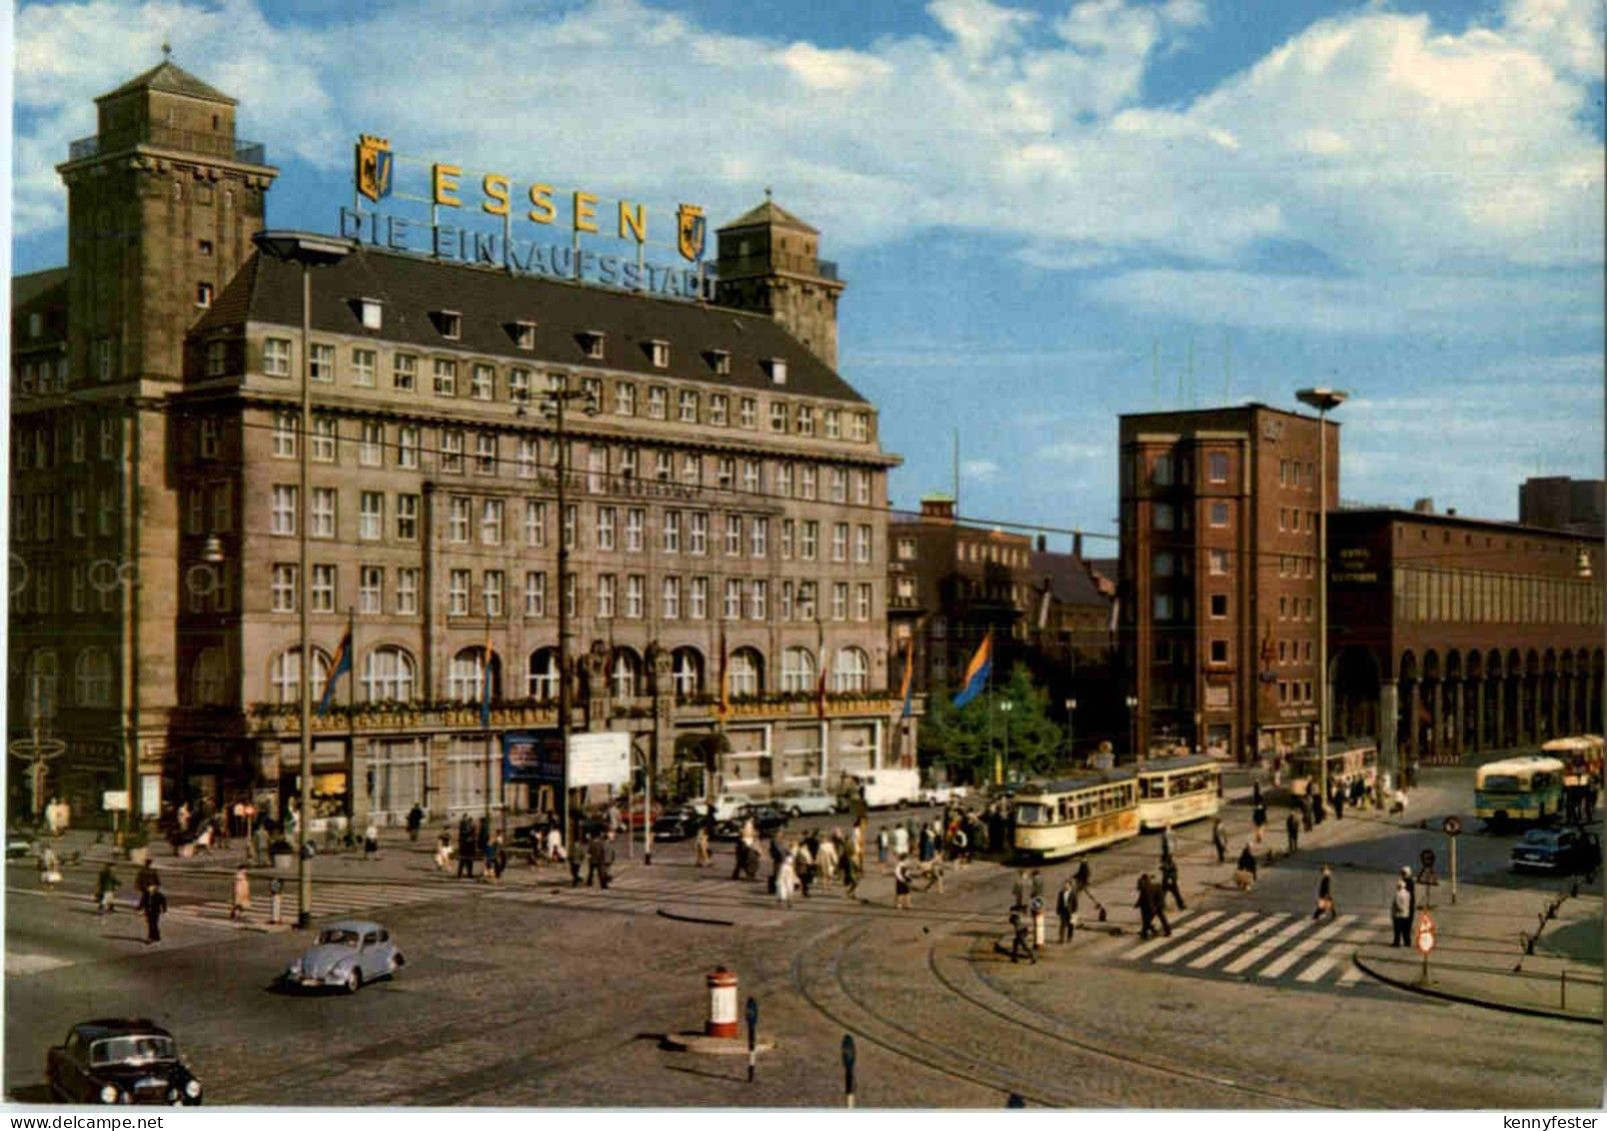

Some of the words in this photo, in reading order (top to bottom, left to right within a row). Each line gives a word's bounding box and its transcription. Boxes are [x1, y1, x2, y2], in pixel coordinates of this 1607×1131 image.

[433, 162, 646, 242] ESSEN
[339, 206, 408, 251] DIE
[433, 226, 719, 300] EINKAUFSSTADT
